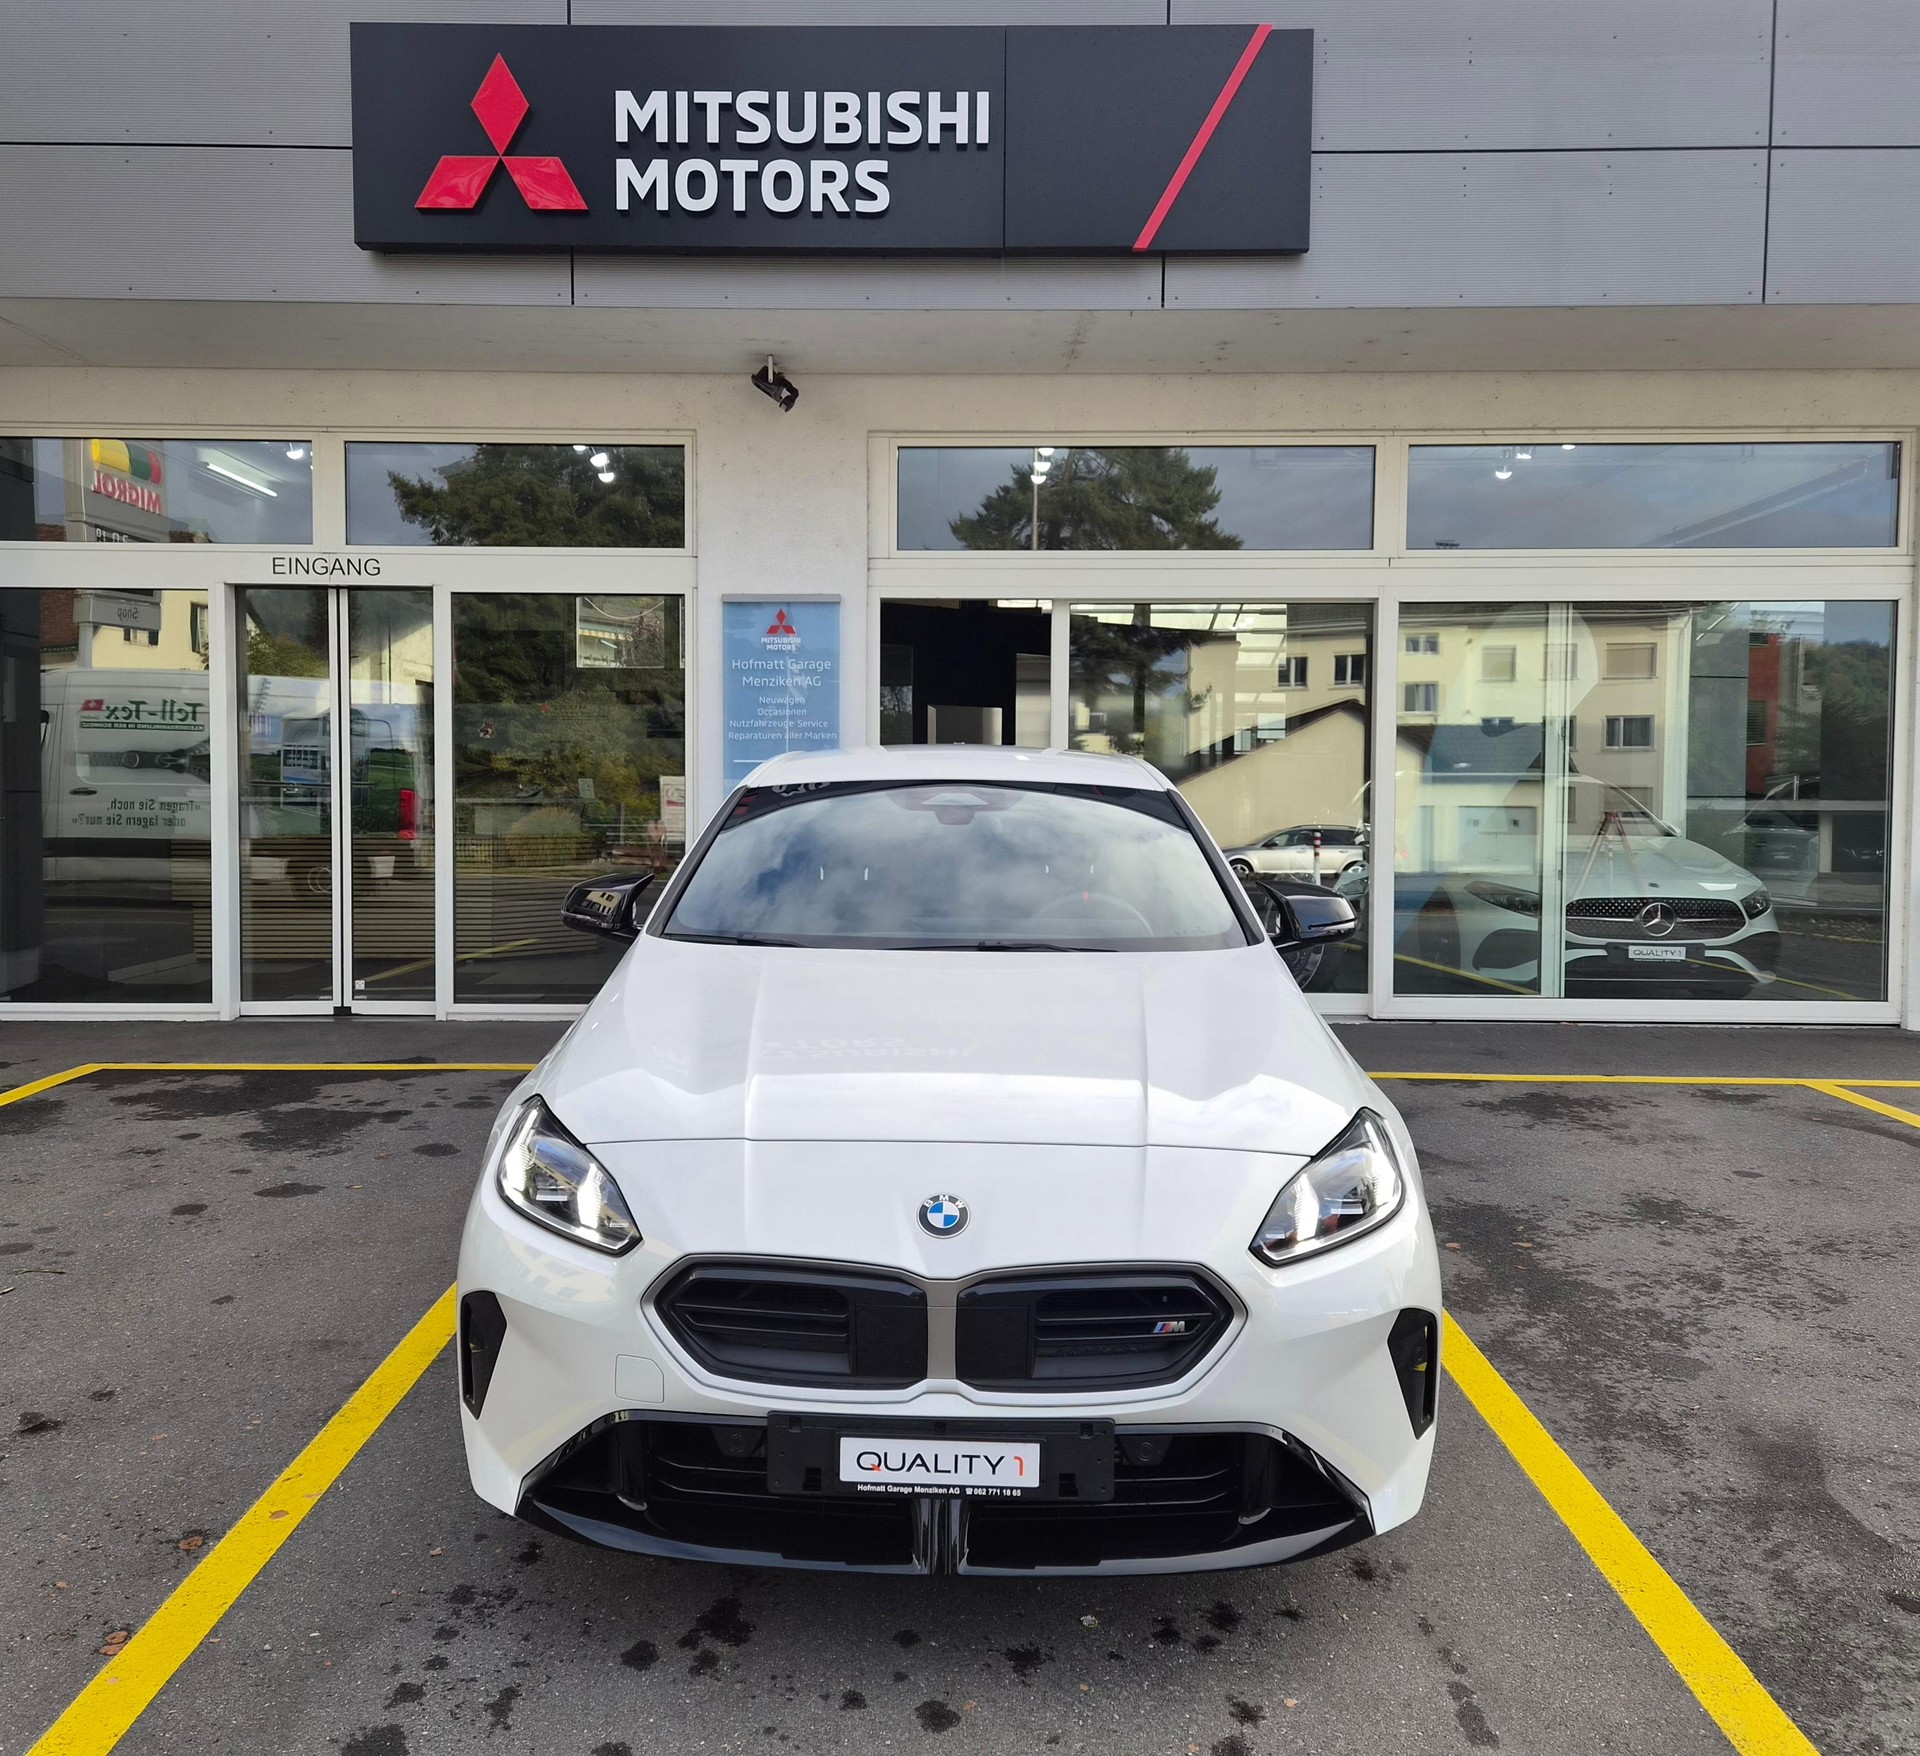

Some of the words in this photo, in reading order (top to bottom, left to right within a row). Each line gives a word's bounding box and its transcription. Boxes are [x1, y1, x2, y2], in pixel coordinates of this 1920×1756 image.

[614, 89, 990, 145] MITSUBISHI
[615, 158, 891, 214] MOTORS
[272, 556, 381, 576] EINGANG
[732, 658, 784, 670] Hofmatt
[788, 659, 831, 672] Garage
[742, 675, 801, 686] Menziken
[804, 676, 822, 687] AG
[759, 696, 805, 706] Neuwagen
[757, 708, 807, 716] Occasionen
[729, 719, 794, 729] Nutzfahrzeuge
[797, 719, 828, 728] Service
[728, 731, 782, 742] Reparaturen
[784, 731, 802, 740] aller
[805, 731, 837, 740] Marken
[923, 1194, 966, 1209] BMW
[856, 1451, 1005, 1476] QUALITY
[1013, 1456, 1024, 1477] 1
[857, 1484, 886, 1492] Hofmatt
[887, 1485, 913, 1494] Garage
[914, 1486, 948, 1494] Menziken
[948, 1487, 960, 1495] AG
[988, 1488, 1001, 1496] 771
